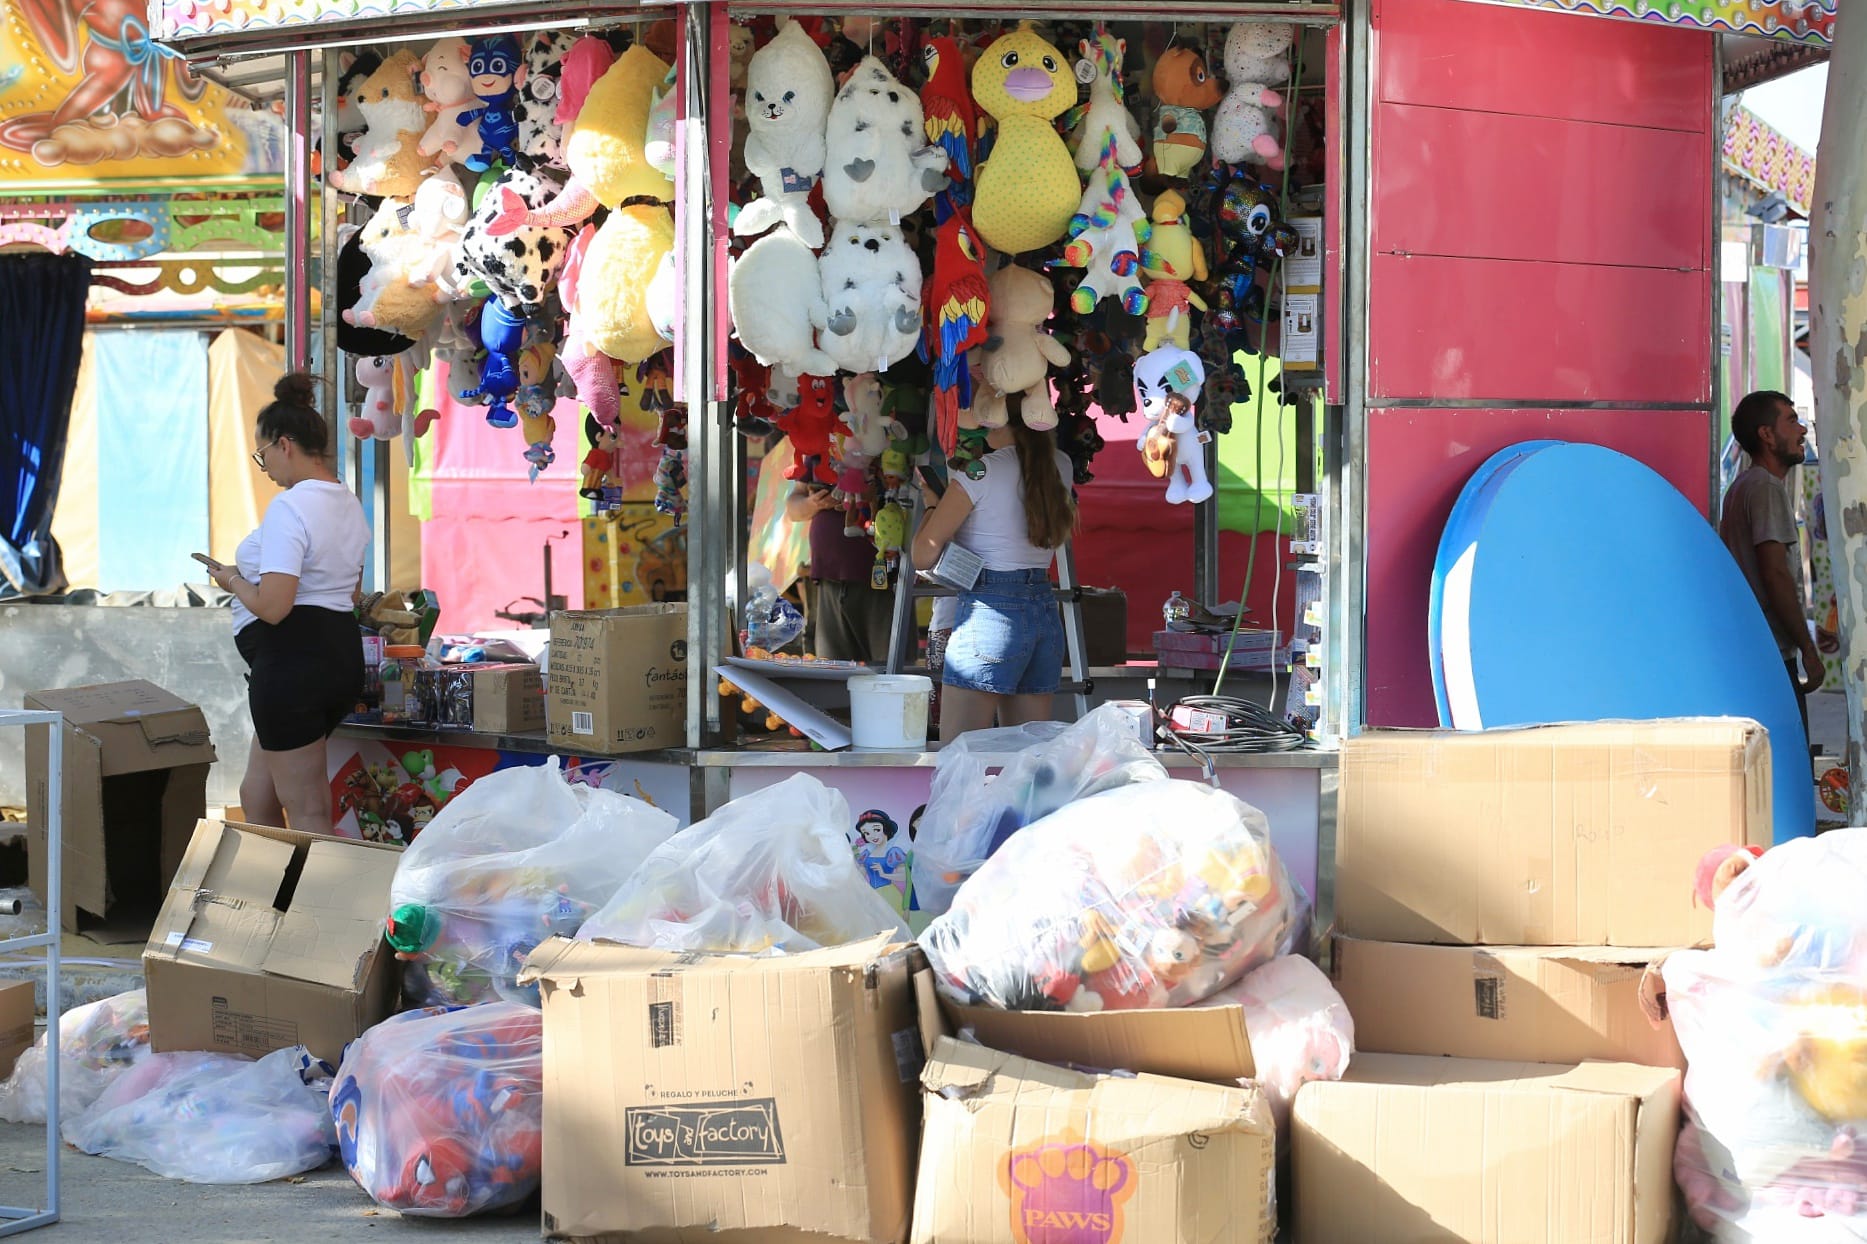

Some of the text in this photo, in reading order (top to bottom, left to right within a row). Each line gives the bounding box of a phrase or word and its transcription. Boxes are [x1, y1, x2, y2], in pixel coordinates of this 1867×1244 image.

[660, 1088, 739, 1099] REGALO Y PELUCHE
[635, 1115, 675, 1155] toys
[698, 1114, 769, 1152] factory
[644, 1168, 768, 1179] WWW.TOYSANDFACTORY.COM
[1023, 1208, 1111, 1231] PAWS
